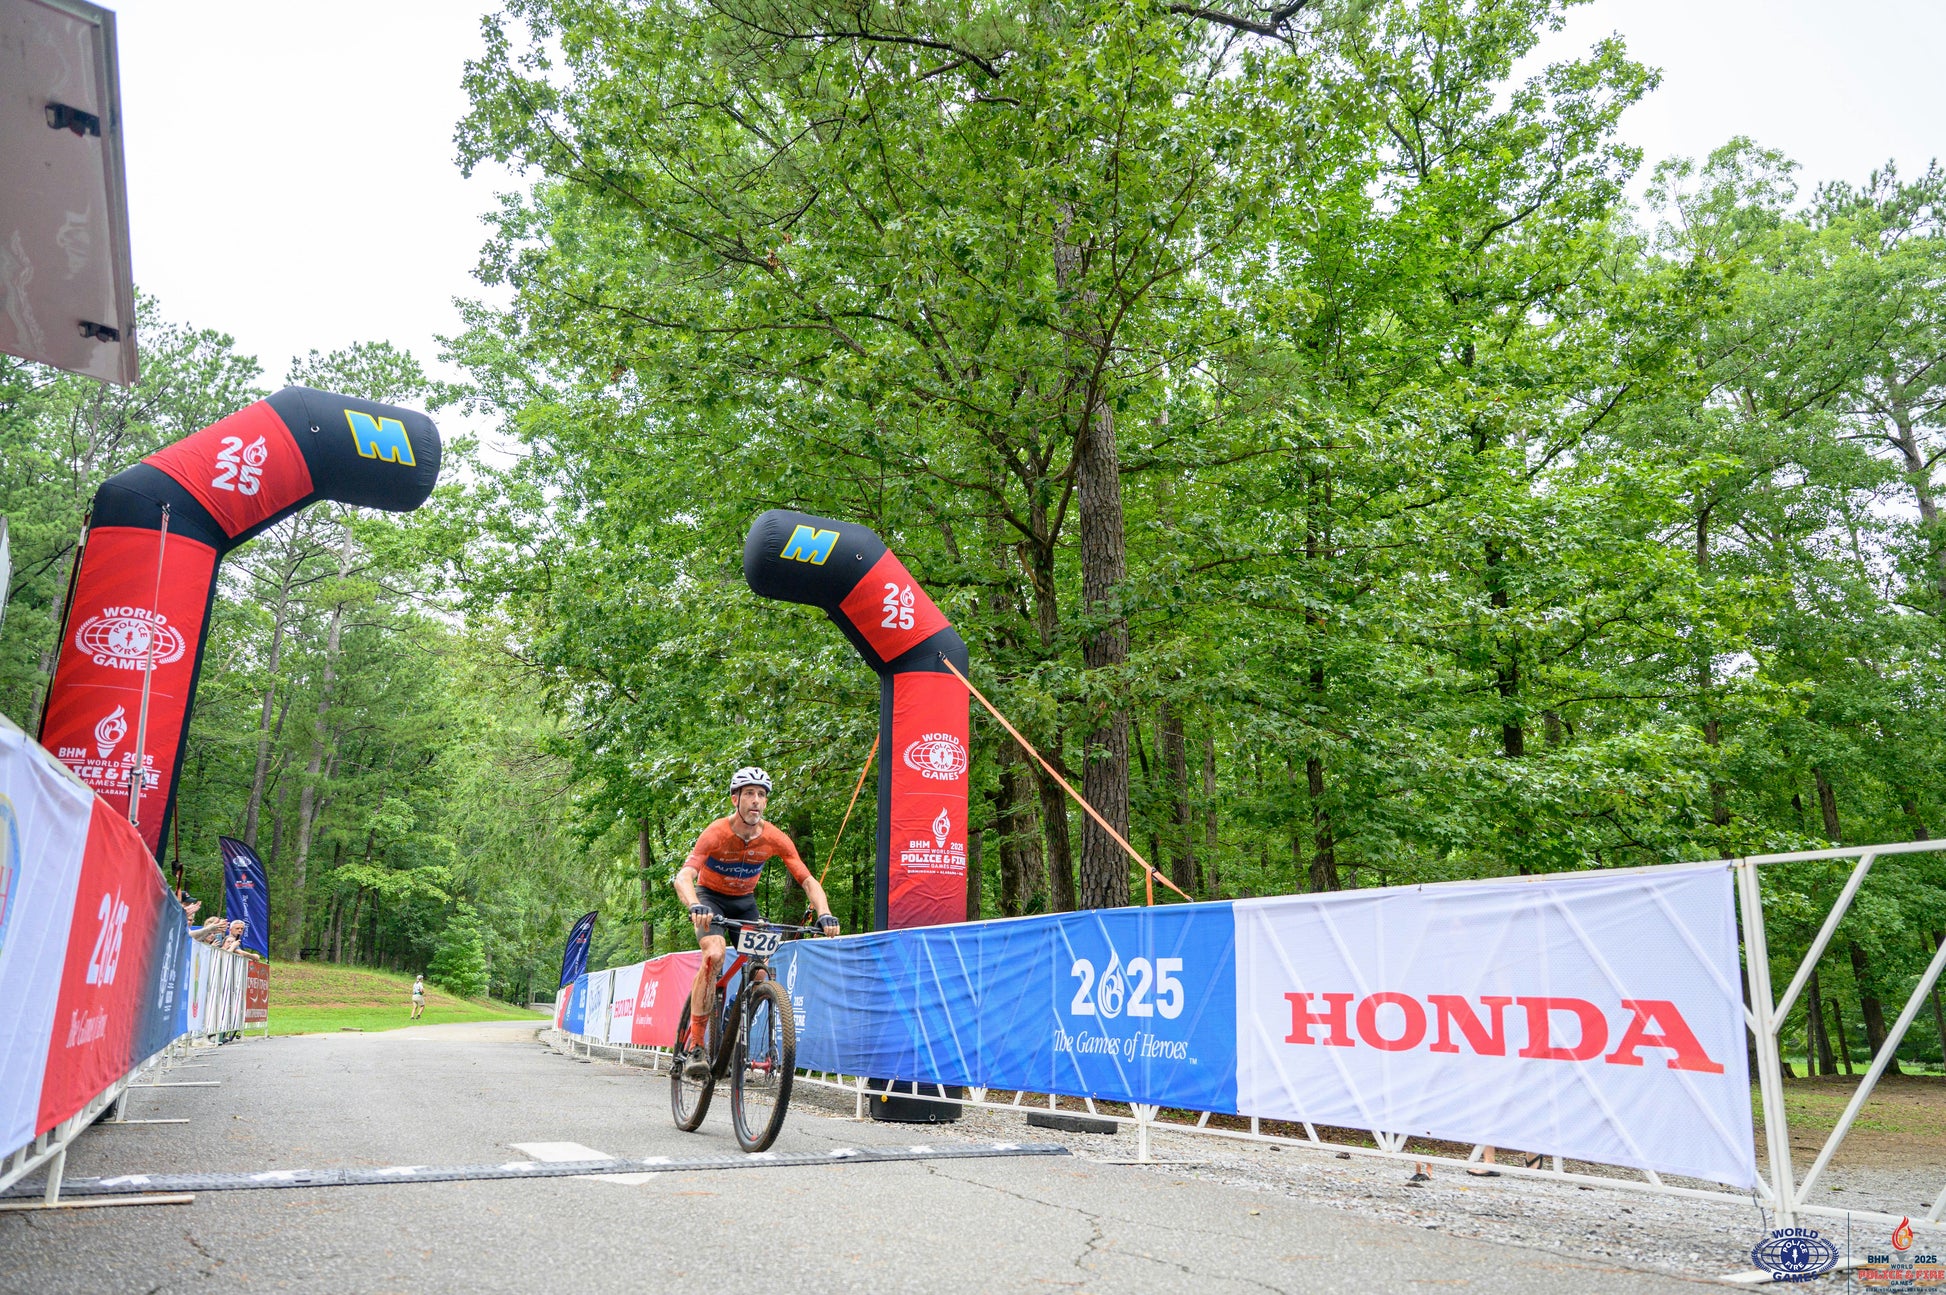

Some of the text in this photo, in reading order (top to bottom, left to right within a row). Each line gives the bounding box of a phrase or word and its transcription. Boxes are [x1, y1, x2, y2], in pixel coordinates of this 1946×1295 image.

[344, 409, 416, 467] M
[780, 524, 840, 566] M
[103, 606, 167, 625] WORLD
[113, 620, 148, 638] POLICE
[113, 643, 138, 655] FIRE
[93, 653, 157, 671] GAMES
[922, 733, 960, 745] WORLD
[58, 747, 87, 757] BHM
[932, 743, 953, 755] POLICE
[87, 759, 119, 768] WORLD
[106, 769, 119, 779] &
[922, 769, 959, 780] GAMES
[910, 840, 930, 848] BHM
[901, 853, 942, 863] POLICE
[943, 855, 950, 864] &
[743, 931, 777, 952] 526
[1284, 992, 1725, 1075] HONDA
[1054, 1029, 1074, 1053] The
[1076, 1030, 1121, 1056] Games
[1123, 1031, 1141, 1063] of
[1140, 1033, 1188, 1060] Heroes
